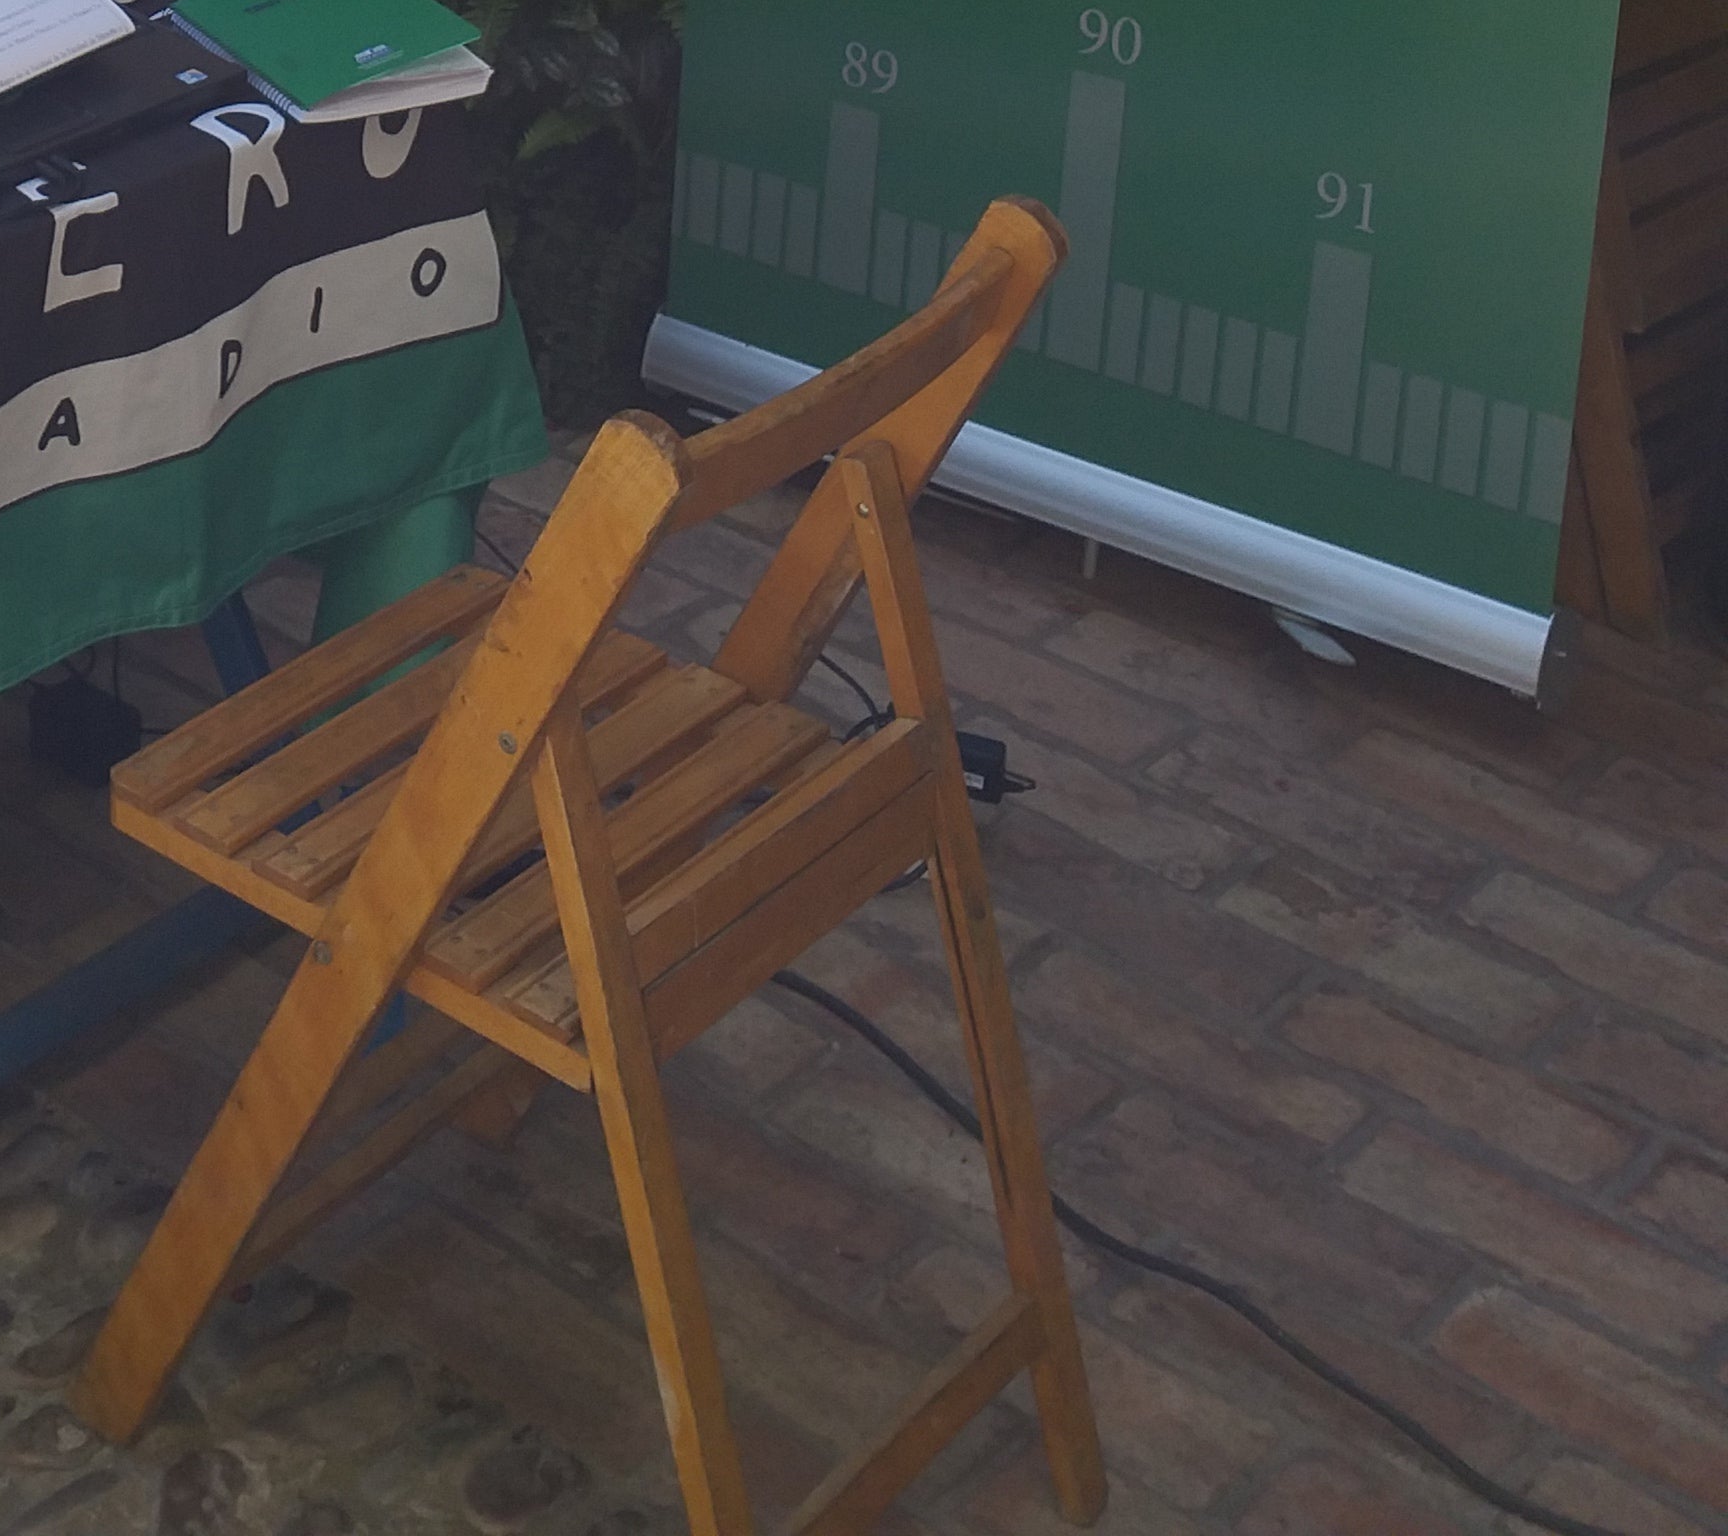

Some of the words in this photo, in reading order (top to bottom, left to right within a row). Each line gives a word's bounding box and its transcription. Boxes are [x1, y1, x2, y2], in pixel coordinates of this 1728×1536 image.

[1077, 8, 1143, 66] 90
[840, 41, 899, 95] 89
[1315, 171, 1376, 235] 91
